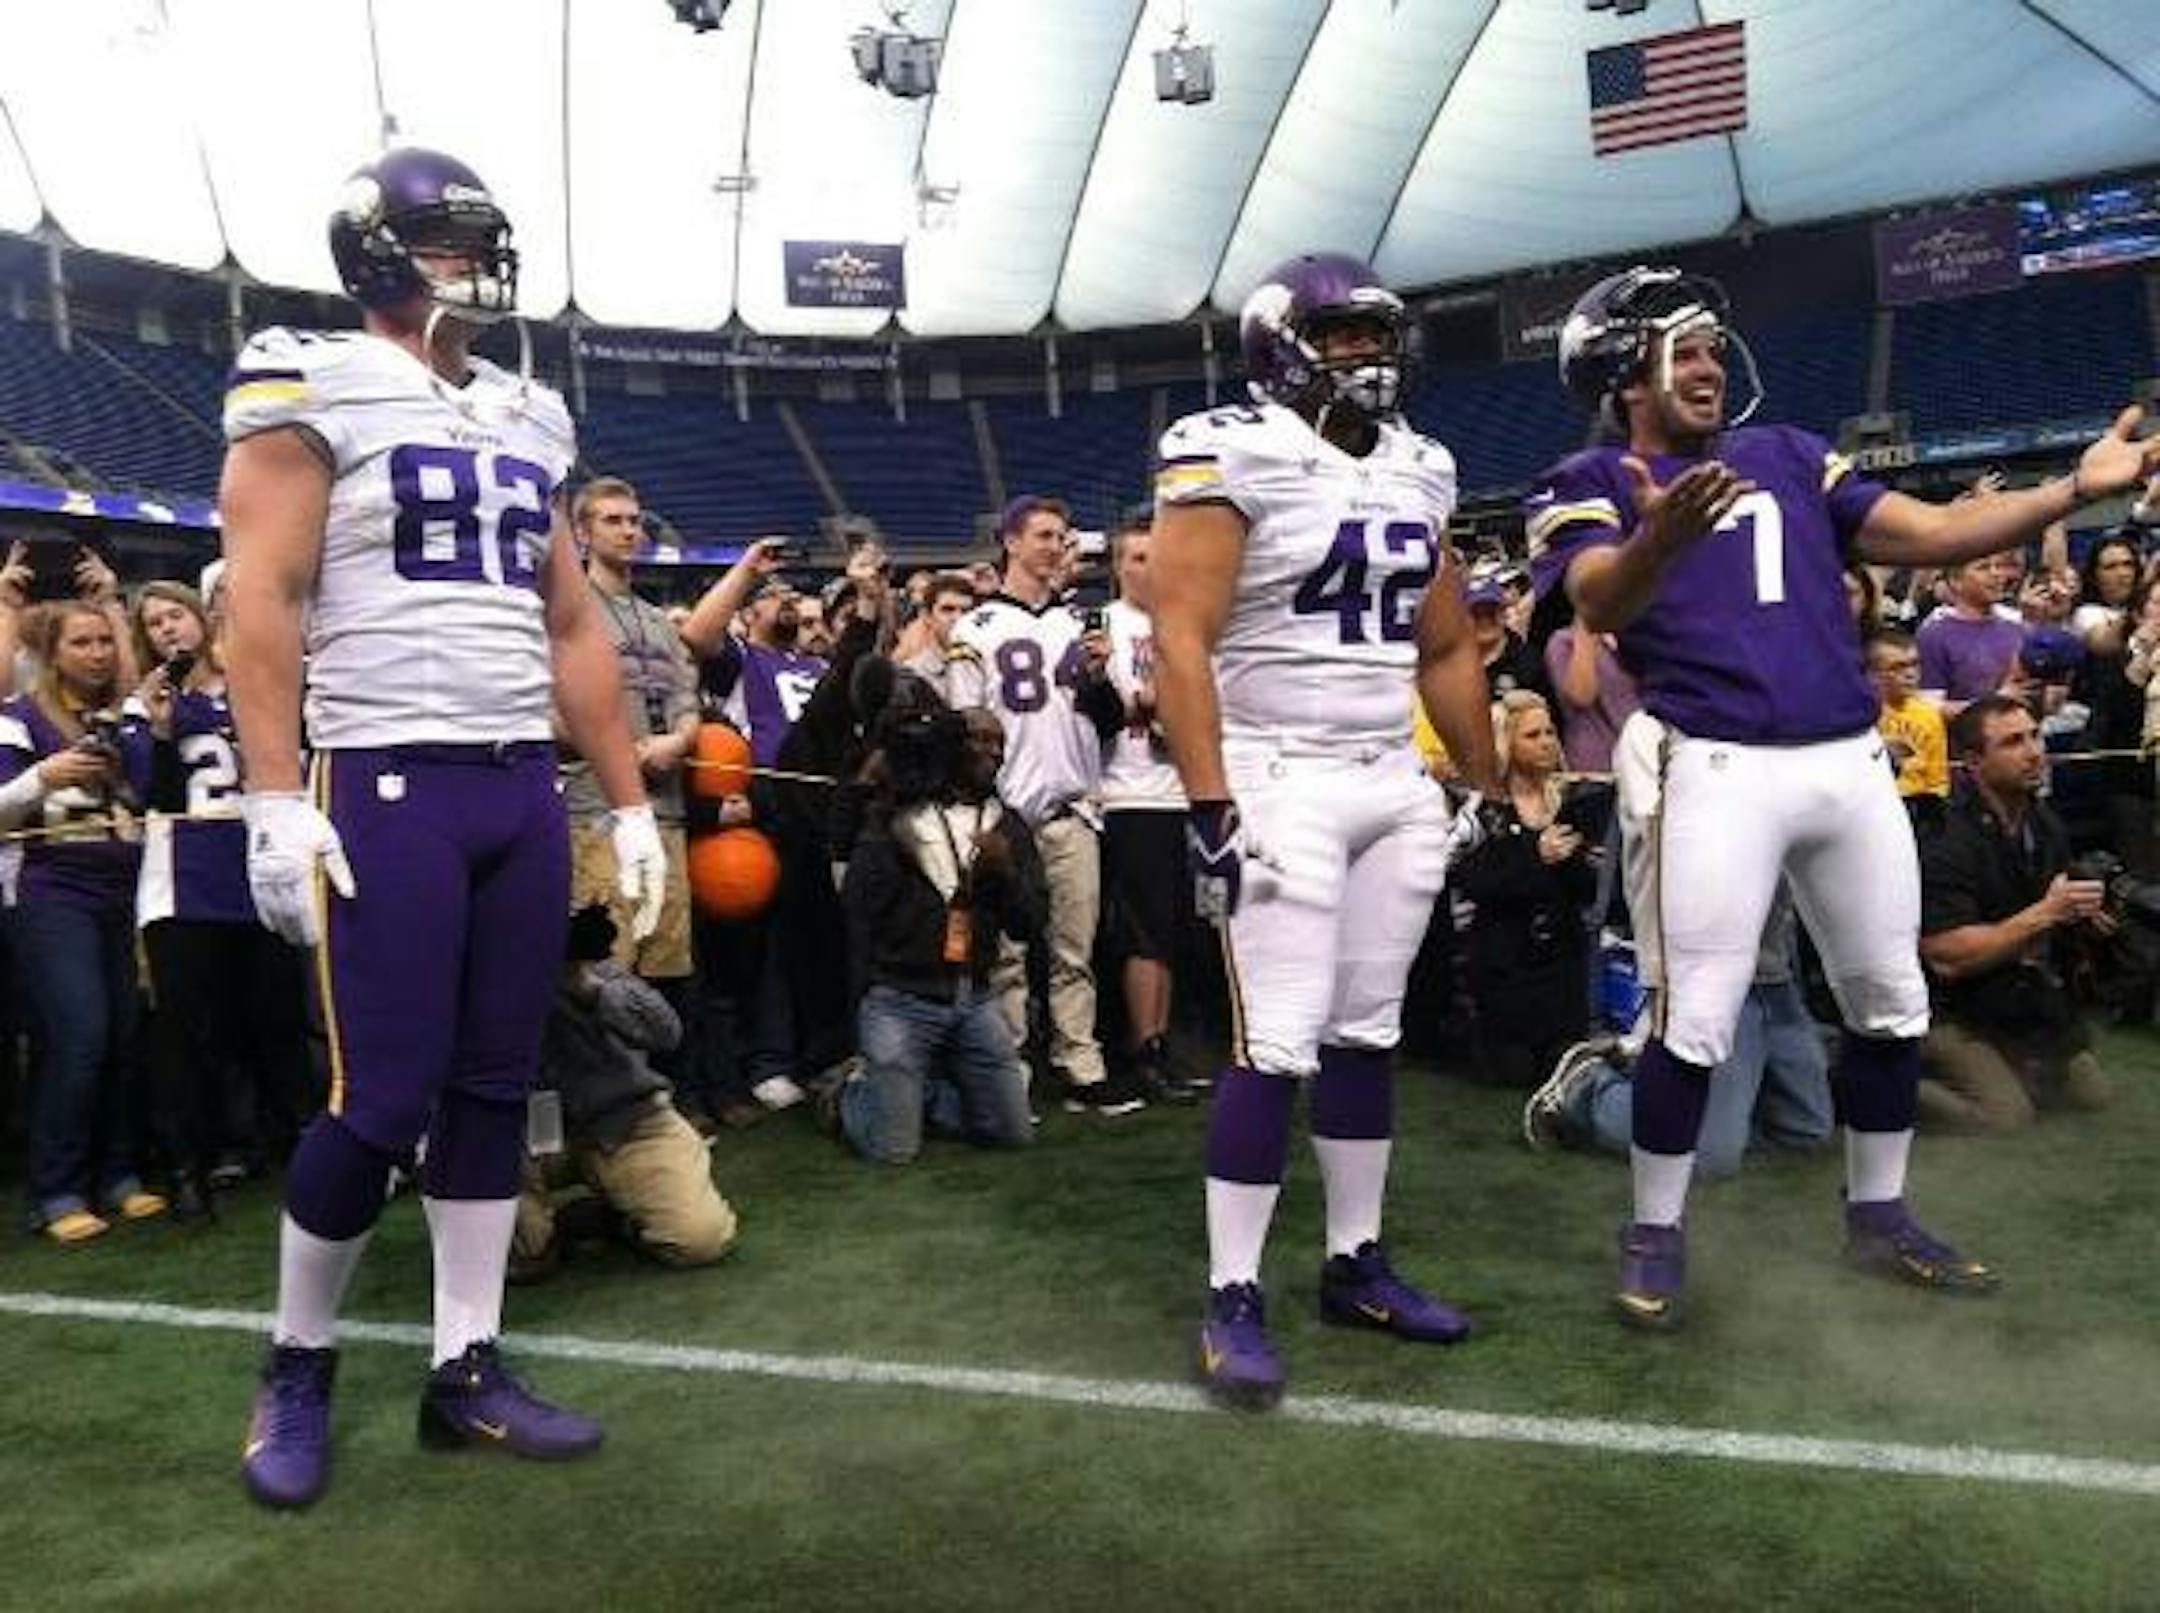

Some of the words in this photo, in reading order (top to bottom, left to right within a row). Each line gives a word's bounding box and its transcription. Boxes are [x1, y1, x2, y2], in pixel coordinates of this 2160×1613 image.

[391, 444, 551, 587] 82
[1712, 490, 1785, 602] 7
[1294, 520, 1439, 644] 42
